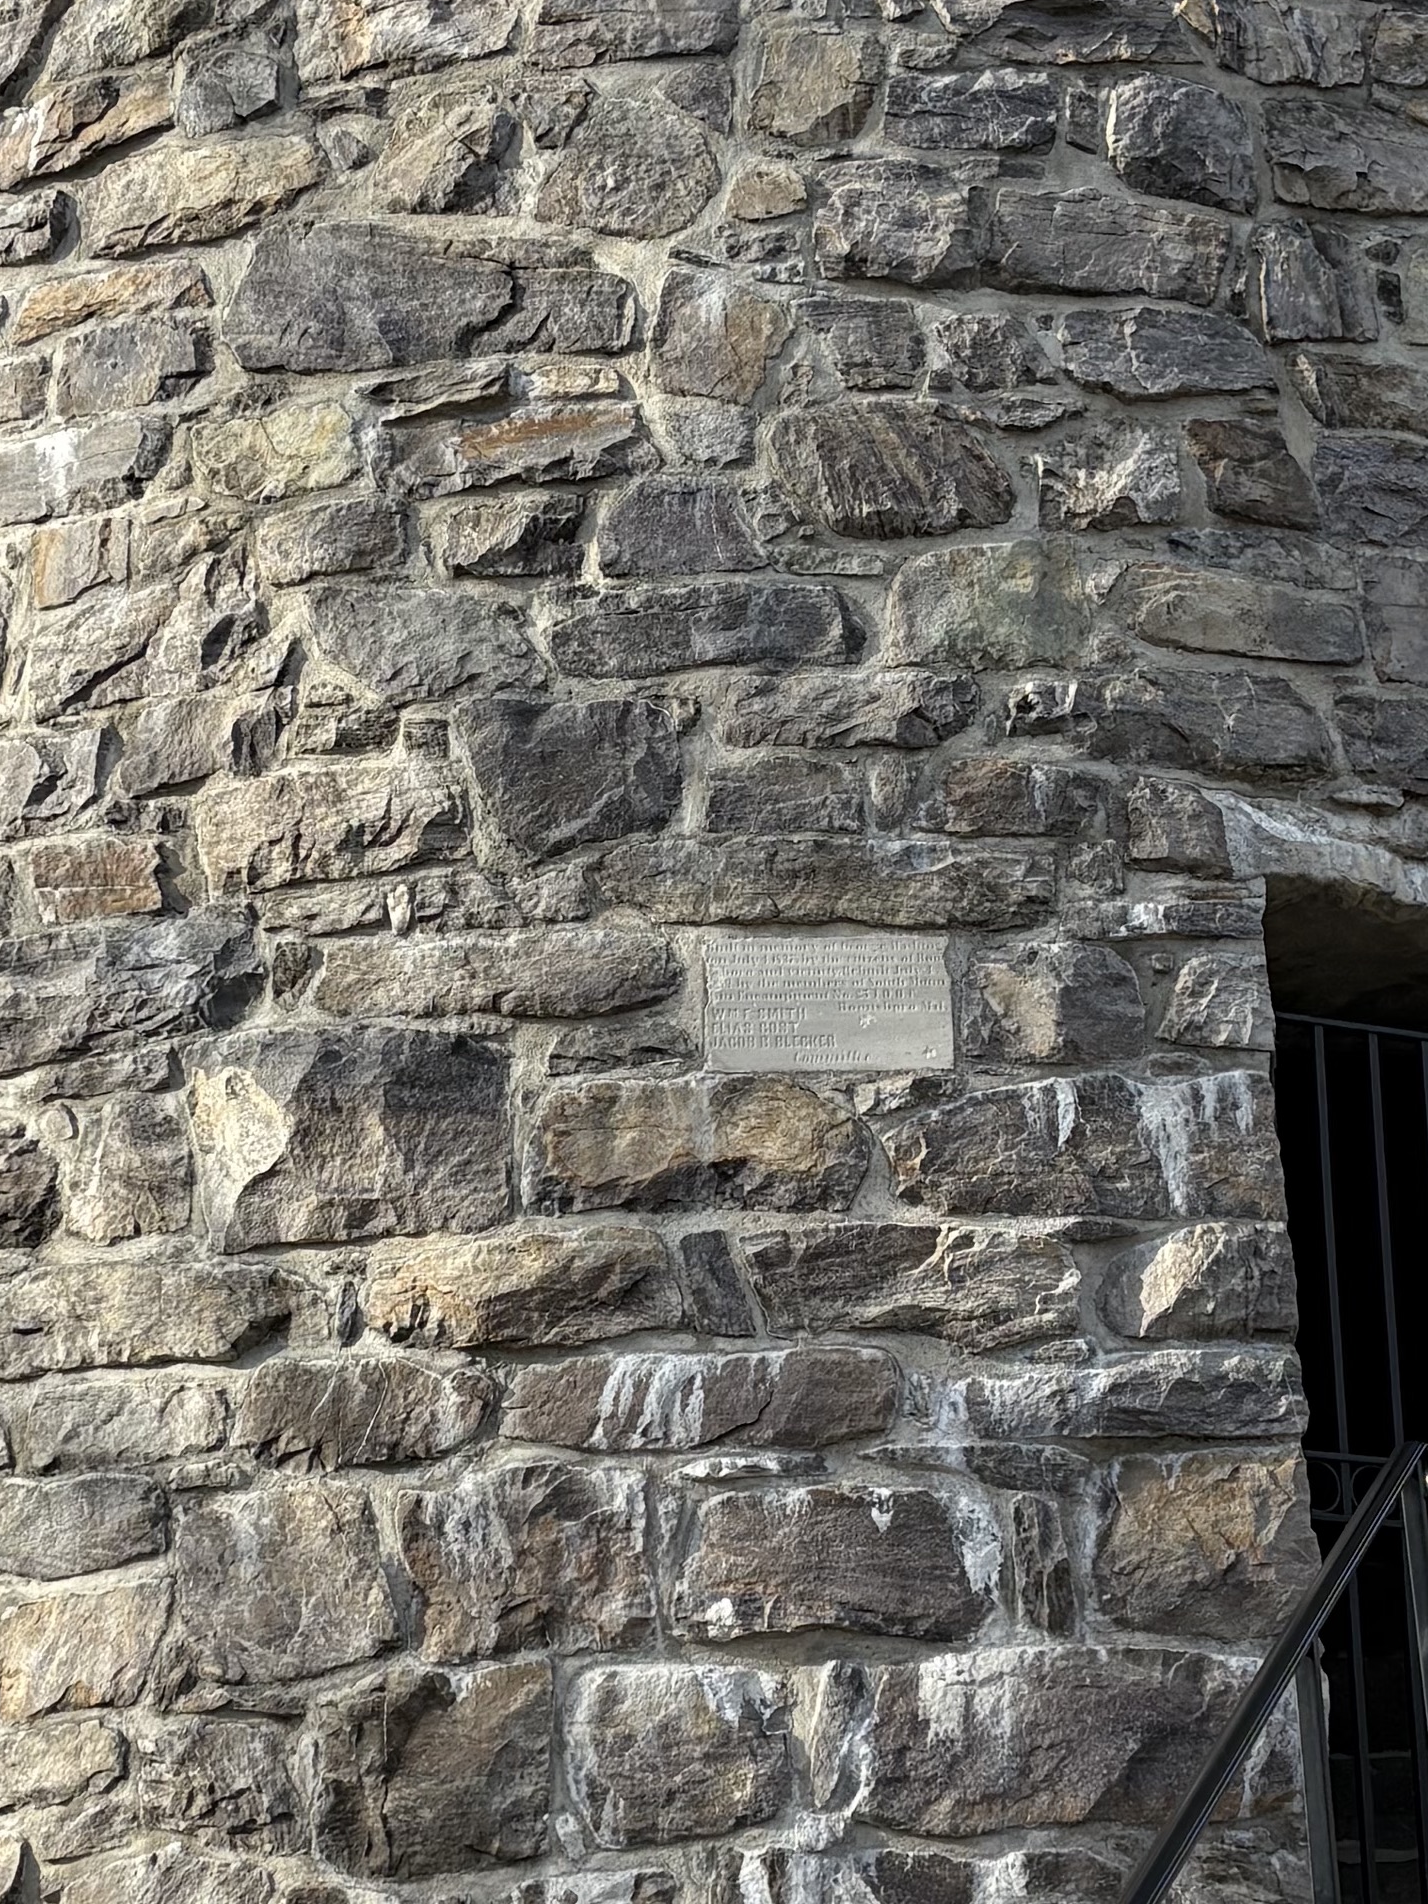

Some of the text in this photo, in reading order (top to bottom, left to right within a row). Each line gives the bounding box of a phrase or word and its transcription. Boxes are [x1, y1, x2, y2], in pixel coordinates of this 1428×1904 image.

[760, 944, 819, 955] memory
[824, 942, 837, 953] of
[732, 955, 761, 968] July
[901, 953, 914, 964] of
[853, 977, 867, 988] of
[757, 1007, 808, 1020] SMITH
[712, 1021, 754, 1035] ELIAS
[709, 1035, 757, 1049] JACOB
